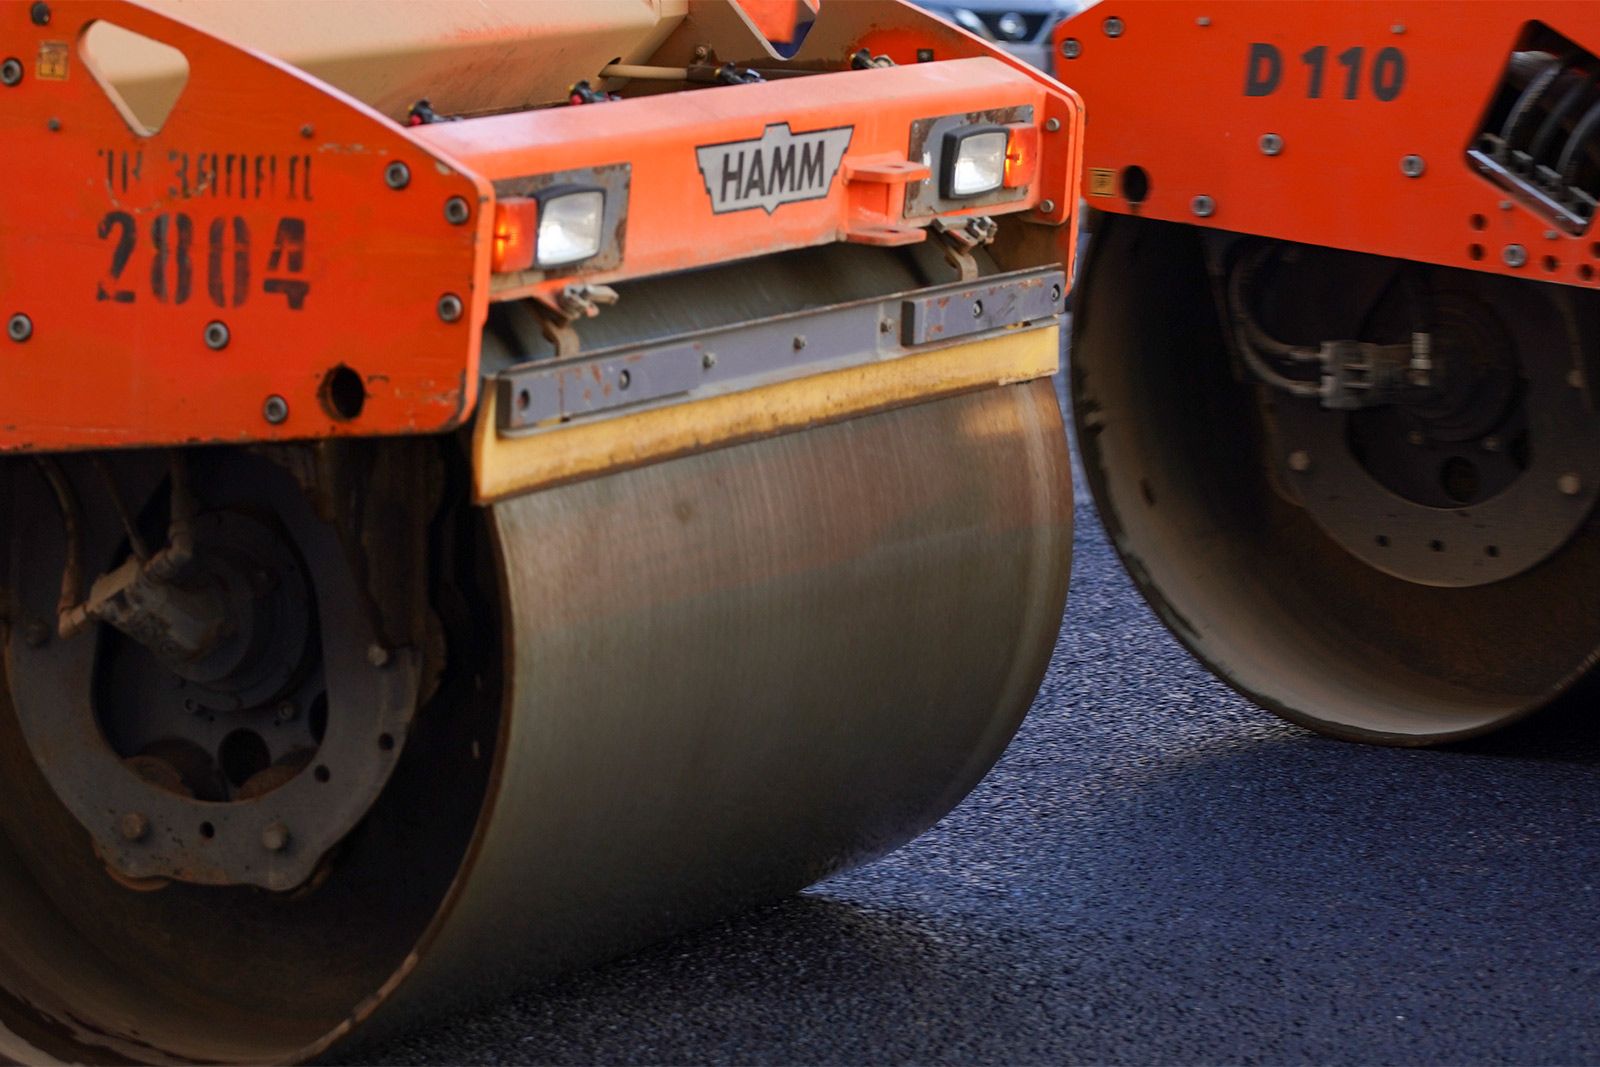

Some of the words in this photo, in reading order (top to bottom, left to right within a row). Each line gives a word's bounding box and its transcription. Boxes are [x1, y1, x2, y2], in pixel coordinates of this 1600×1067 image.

[1244, 42, 1284, 97] D
[1300, 45, 1408, 102] 110
[720, 139, 825, 203] HAMM
[96, 210, 310, 311] 2804
